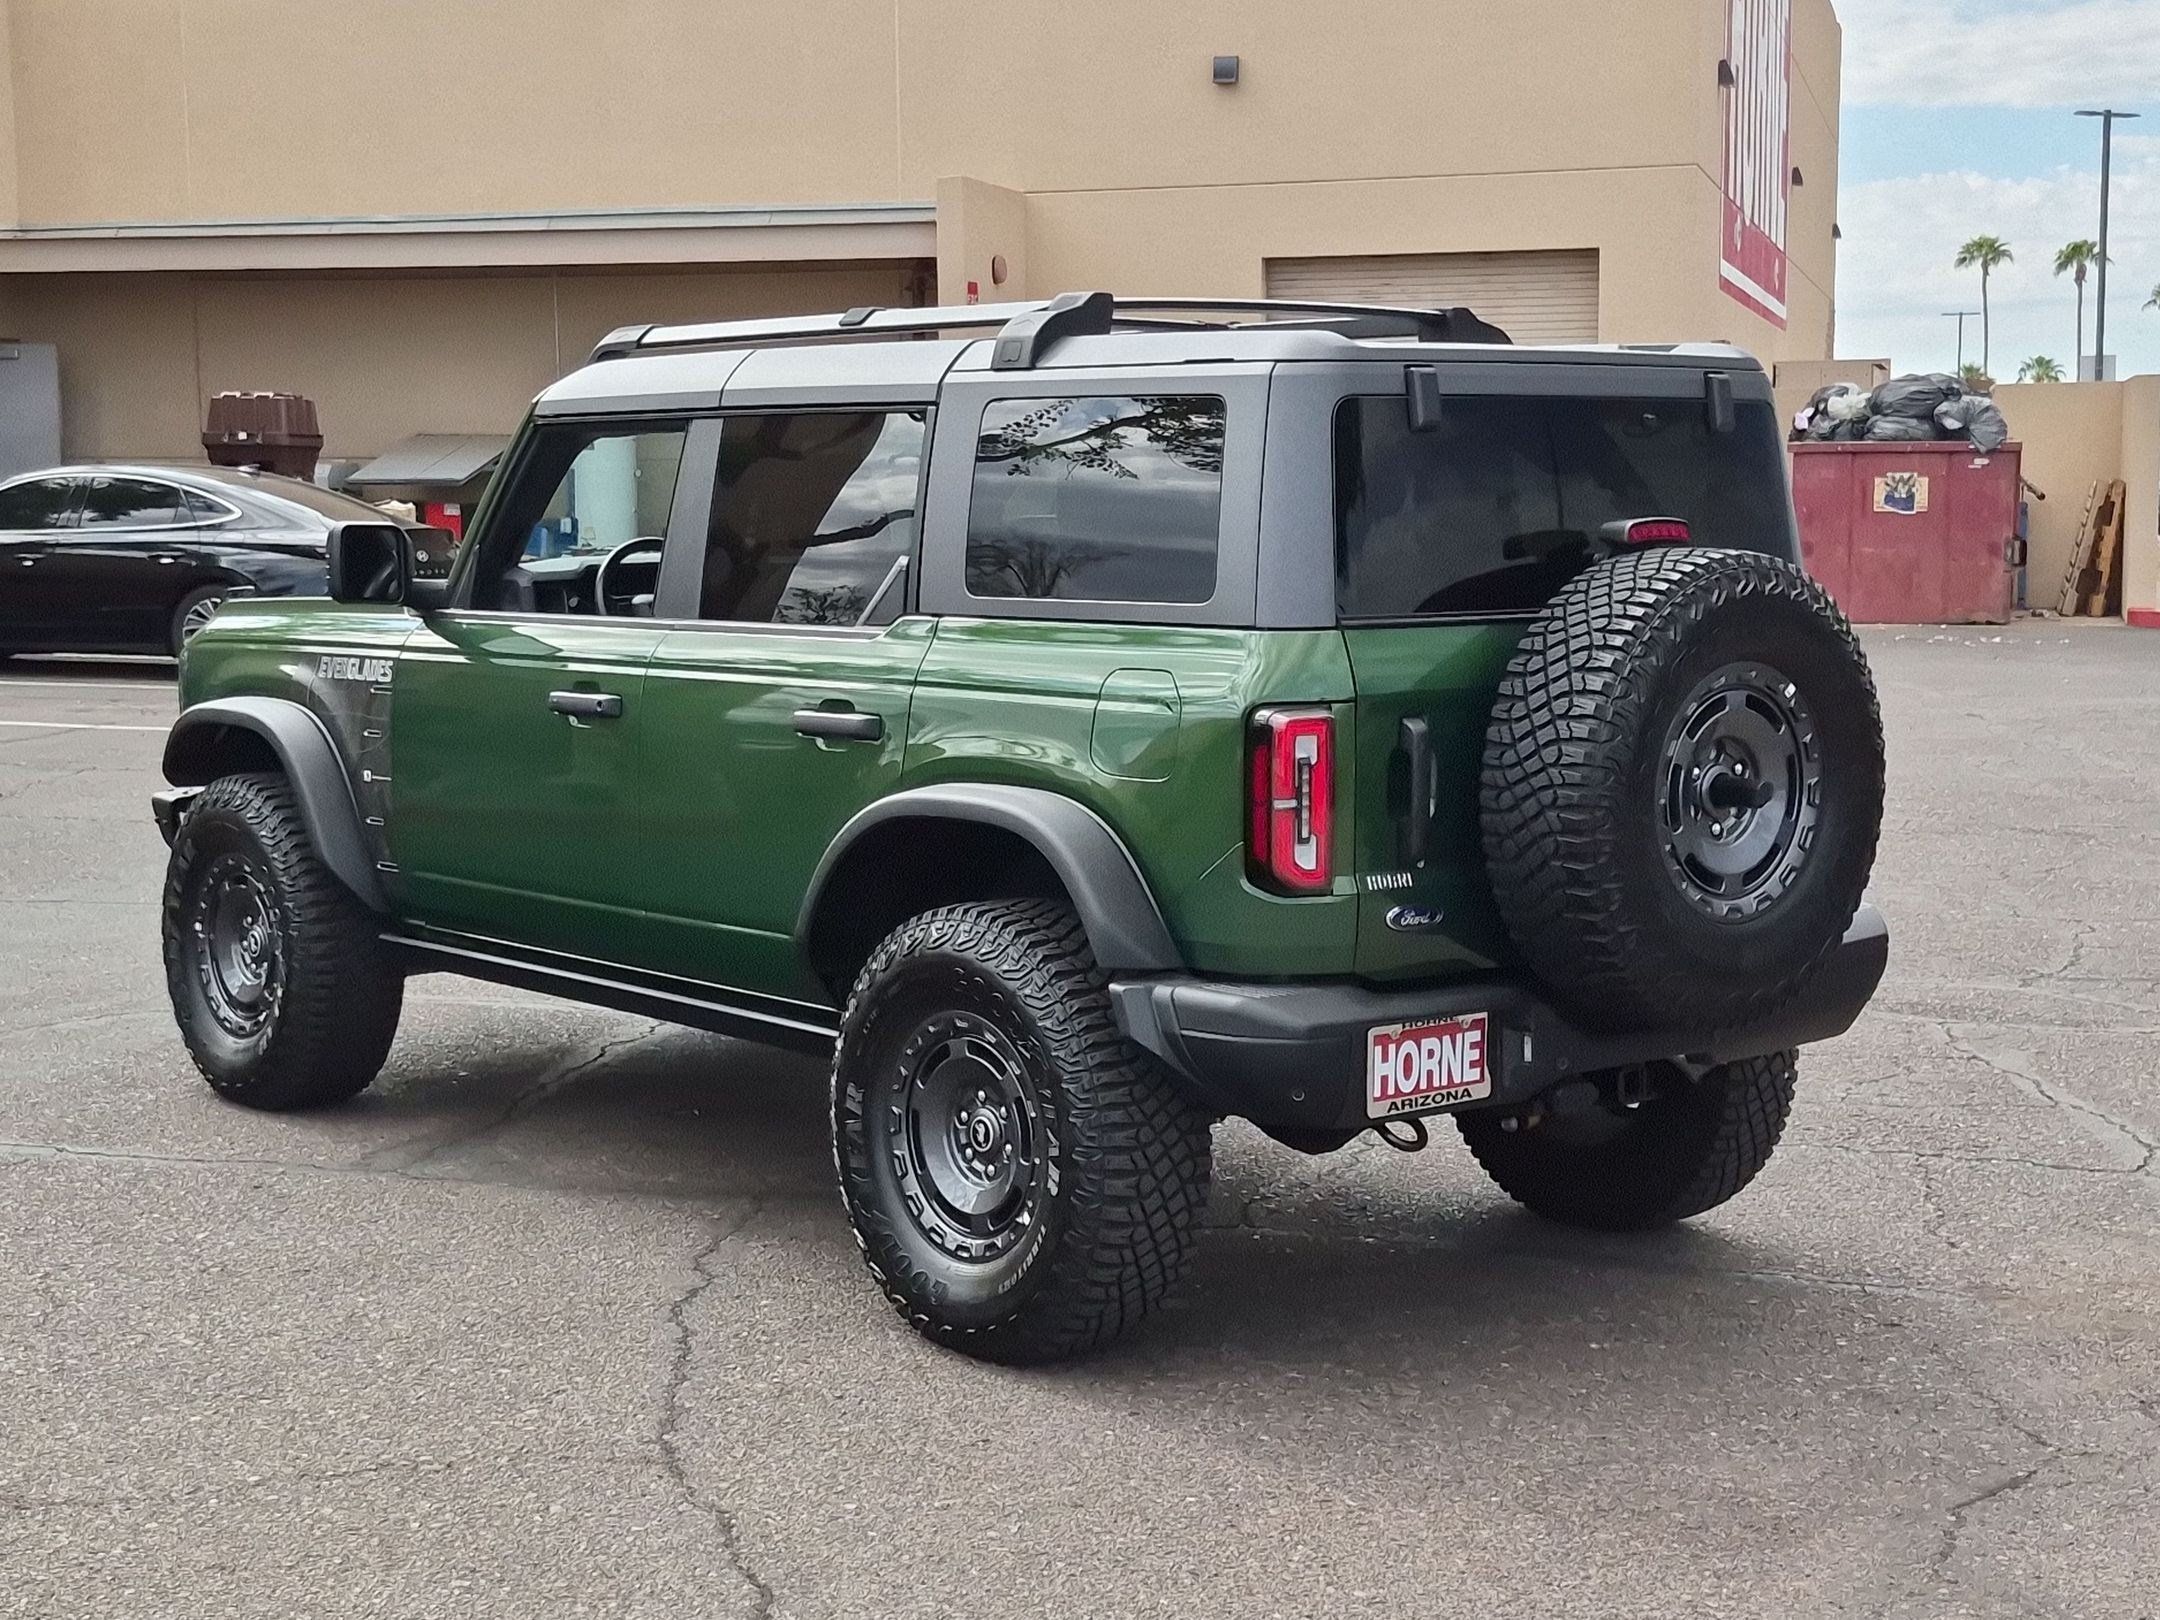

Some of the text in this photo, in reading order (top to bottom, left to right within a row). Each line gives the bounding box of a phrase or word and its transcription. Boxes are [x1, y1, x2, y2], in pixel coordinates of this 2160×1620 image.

[319, 656, 393, 682] EVERGLADES
[1374, 1030, 1481, 1098] HORNE
[1387, 1088, 1472, 1113] ARIZONA
